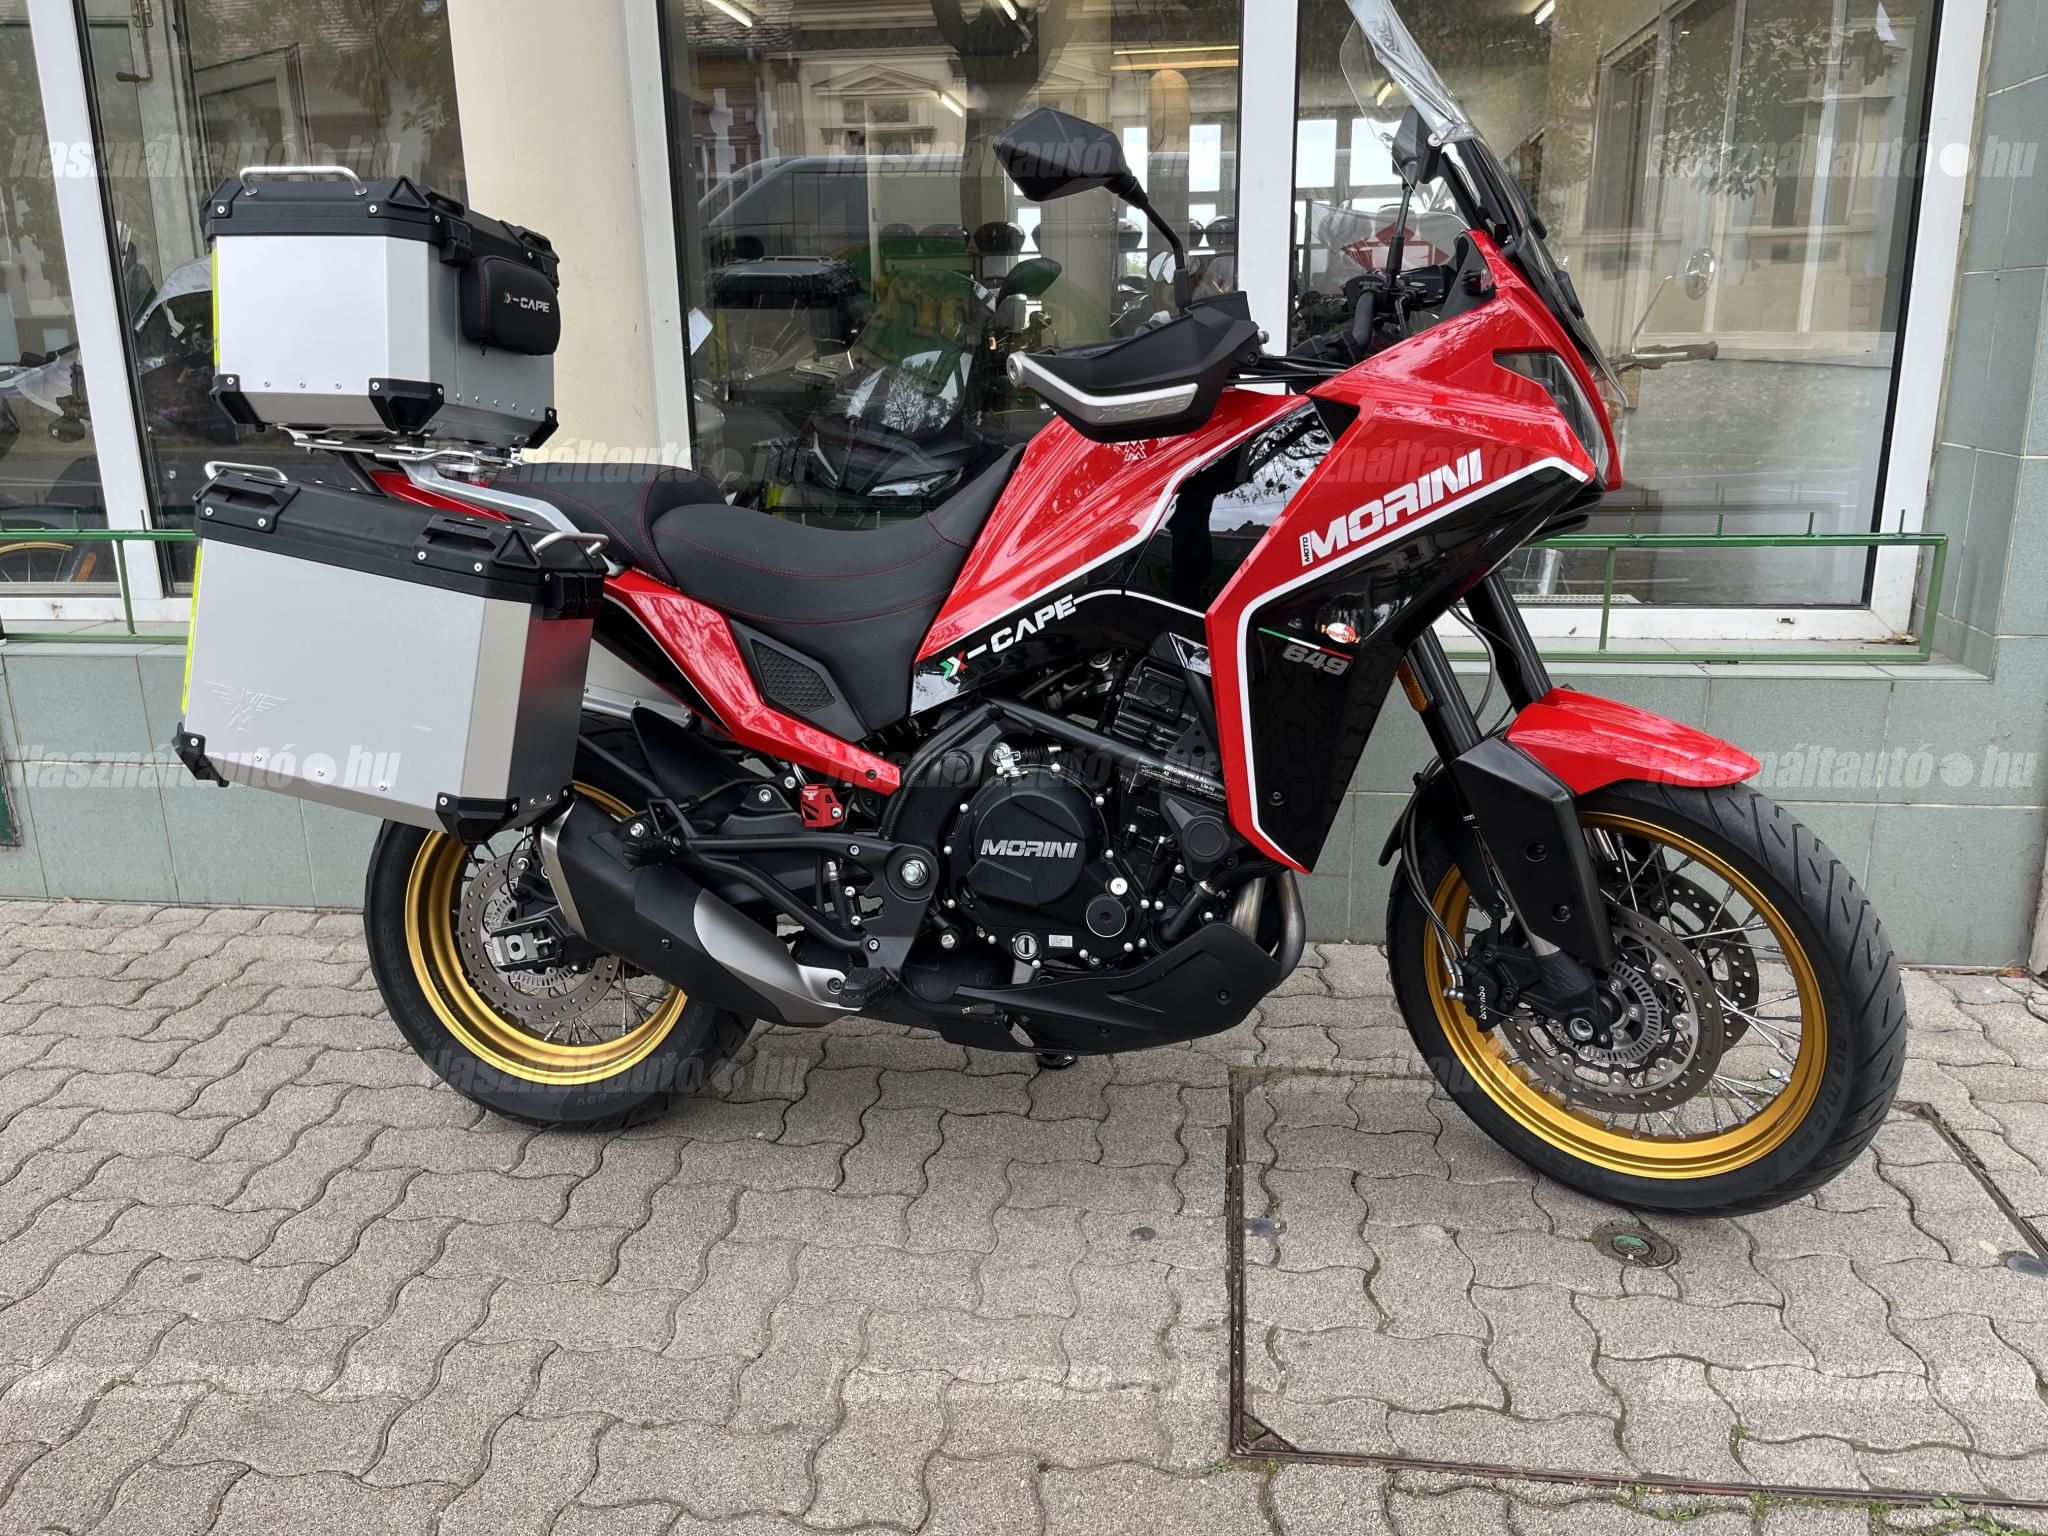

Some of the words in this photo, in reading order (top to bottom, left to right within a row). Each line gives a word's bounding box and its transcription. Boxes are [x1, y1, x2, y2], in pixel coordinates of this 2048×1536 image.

[1300, 448, 1483, 567] MORINI
[1303, 536, 1311, 563] MOTO
[939, 593, 1077, 680] X-CAPE
[1282, 644, 1349, 676] 649
[981, 839, 1078, 859] MORINI
